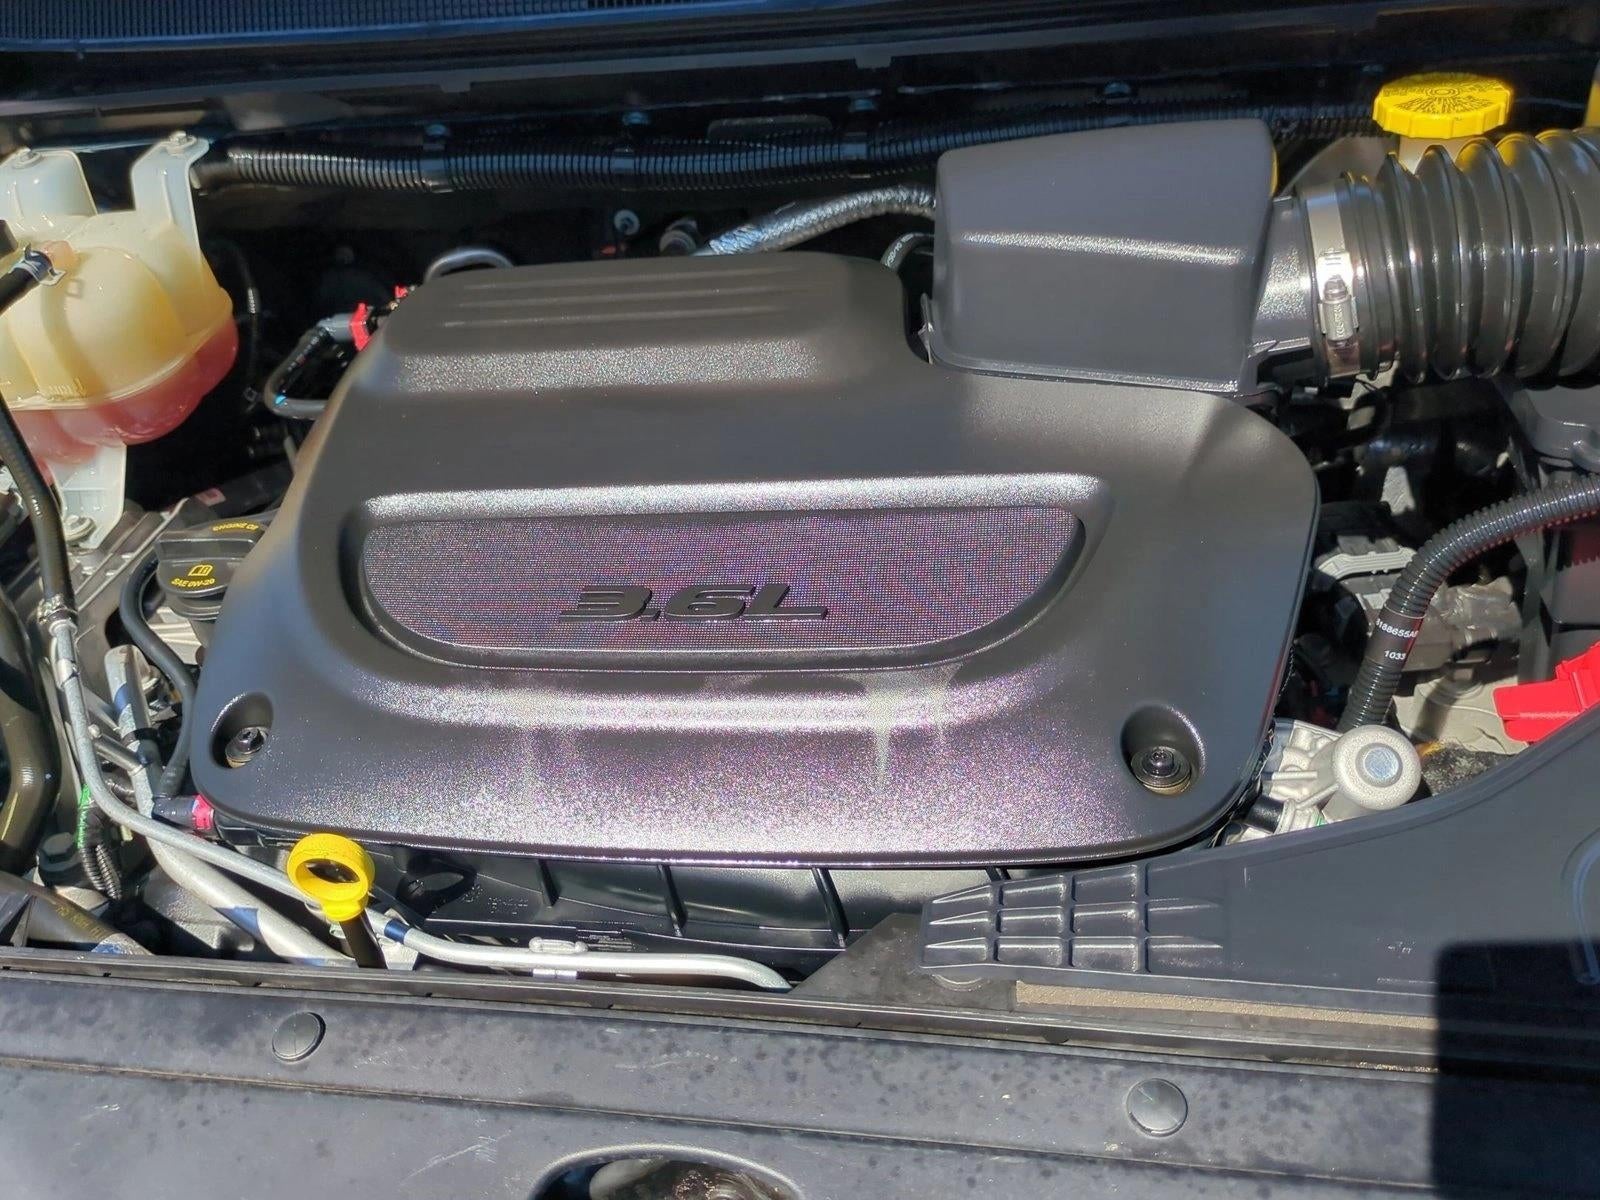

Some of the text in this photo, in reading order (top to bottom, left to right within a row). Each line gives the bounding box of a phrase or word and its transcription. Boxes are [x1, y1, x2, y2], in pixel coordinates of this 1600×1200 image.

[171, 578, 215, 588] SAE 0W-20
[559, 583, 828, 622] 3.6L
